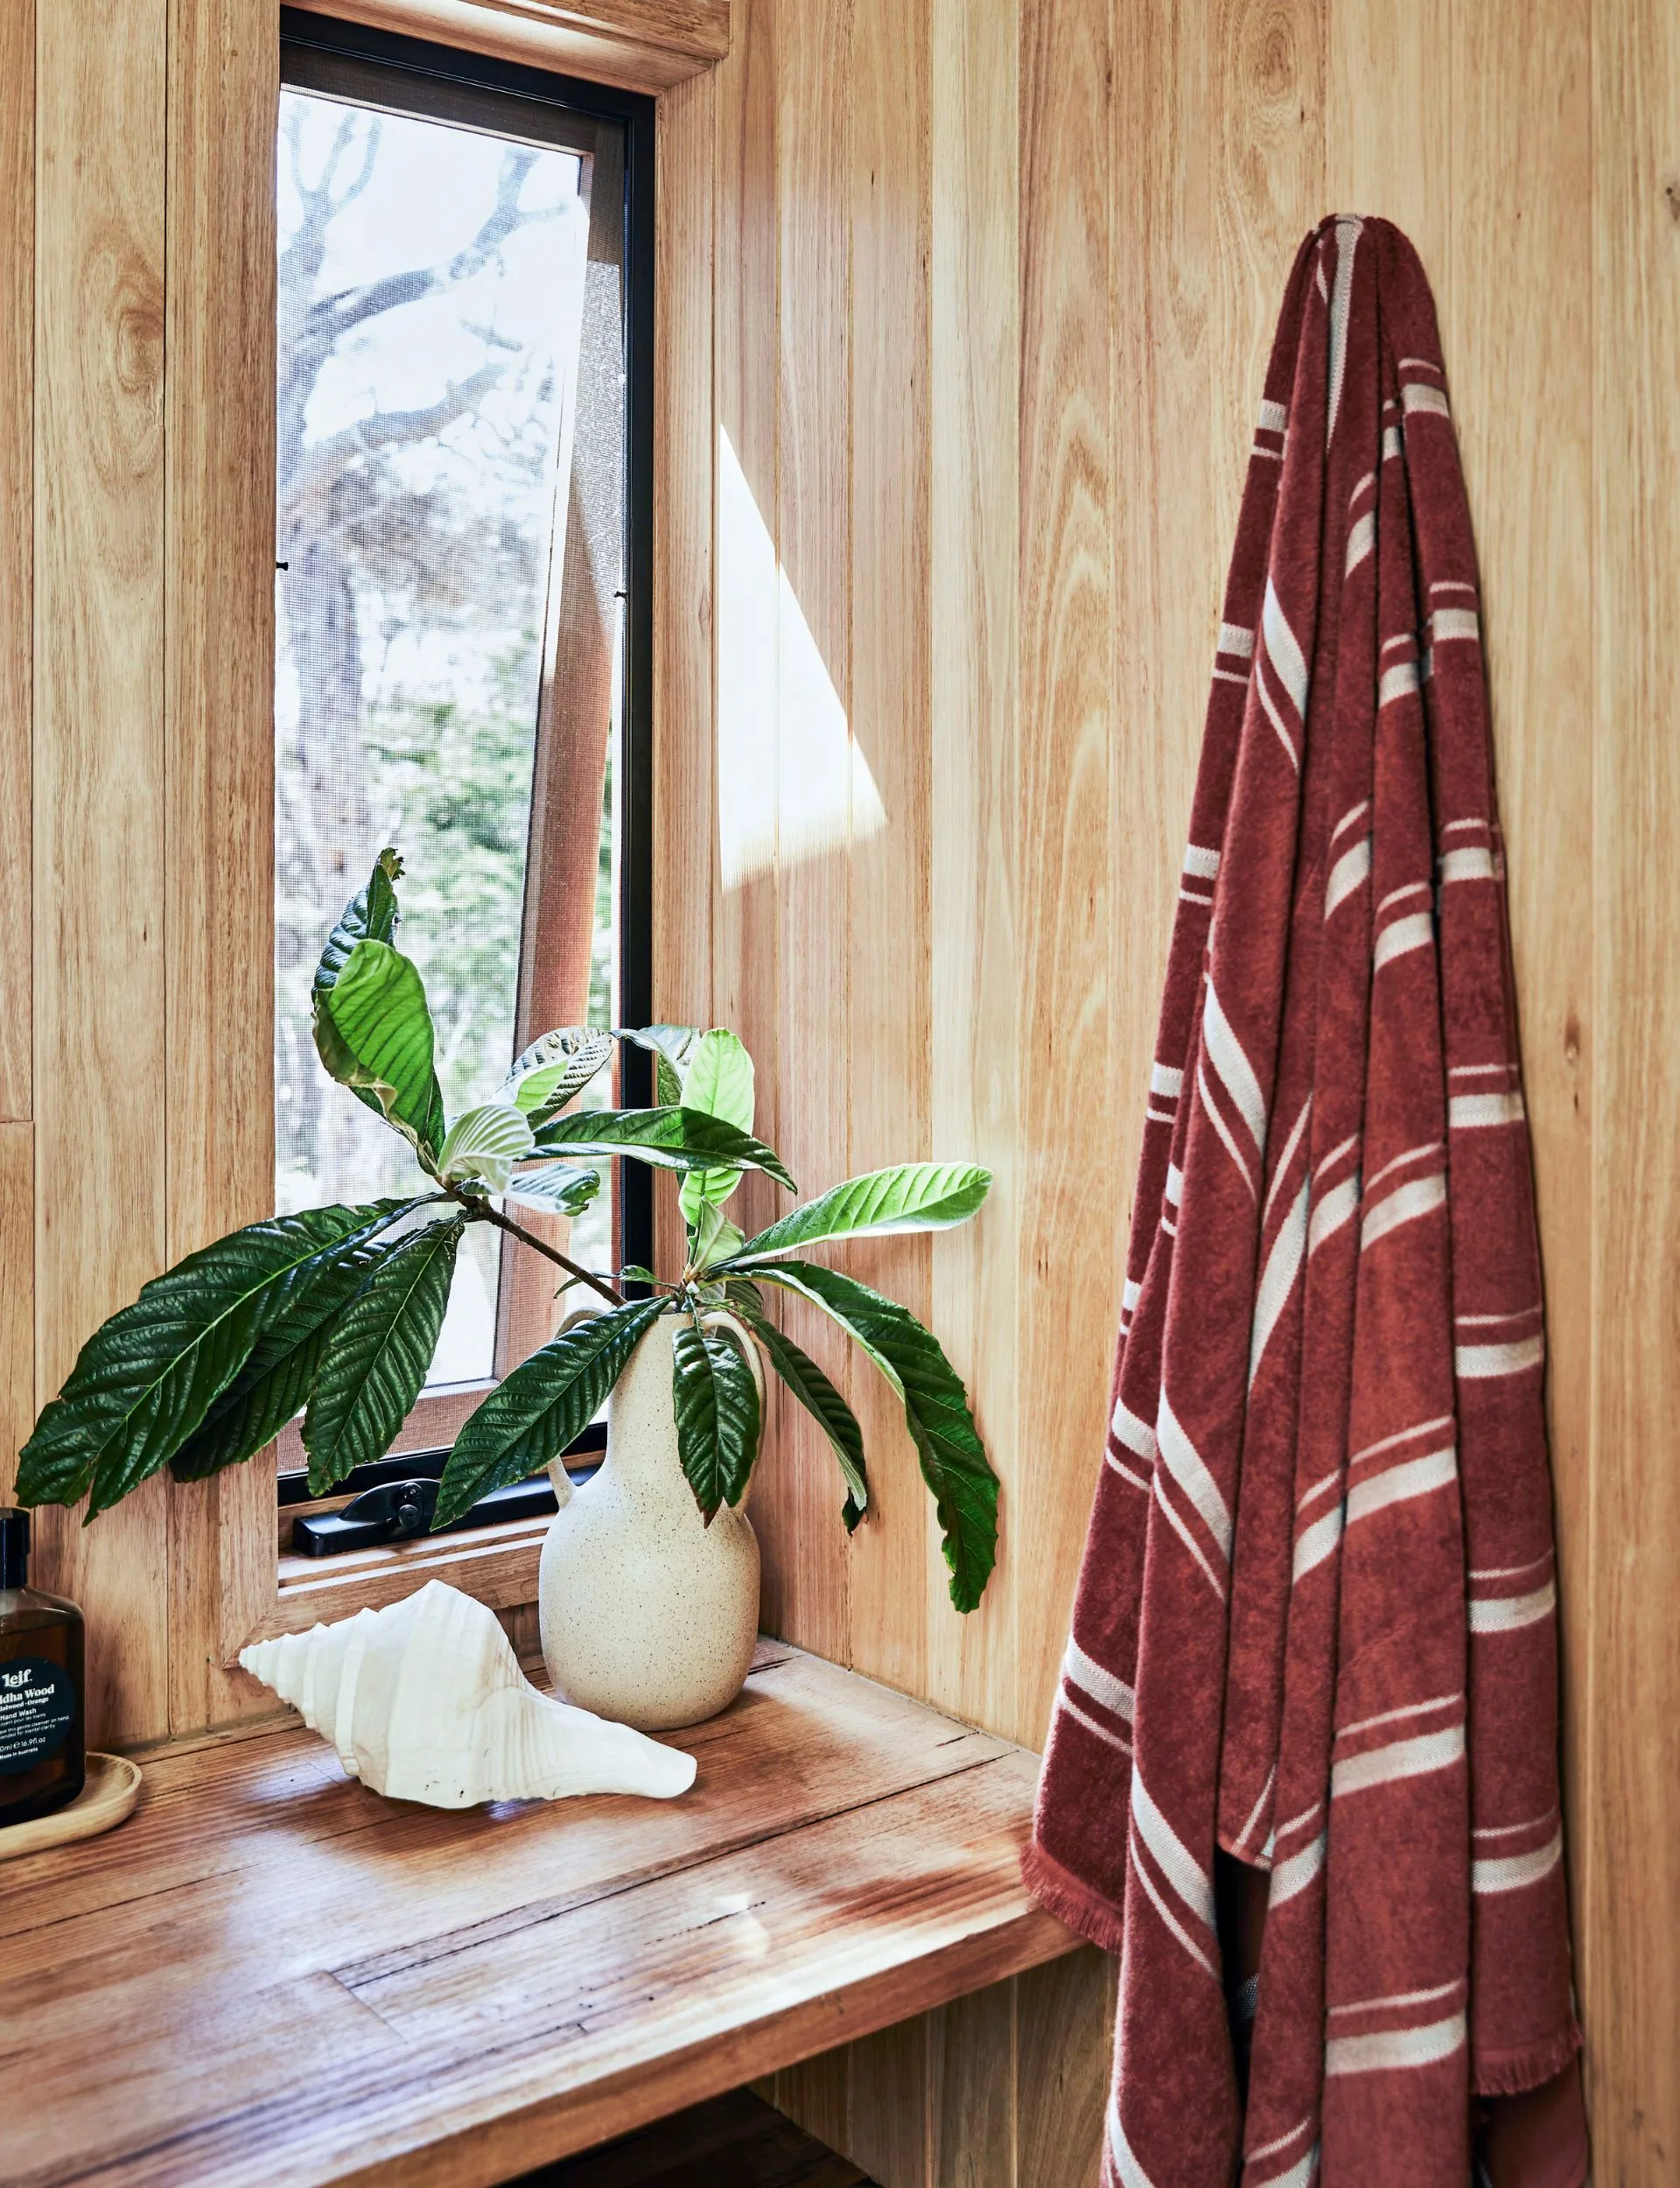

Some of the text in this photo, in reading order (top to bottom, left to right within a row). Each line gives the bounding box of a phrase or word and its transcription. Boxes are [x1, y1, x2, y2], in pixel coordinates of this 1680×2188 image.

[24, 1684, 55, 1699] Wood
[0, 1708, 37, 1721] Hand Wash
[18, 1747, 38, 1756] Australia
